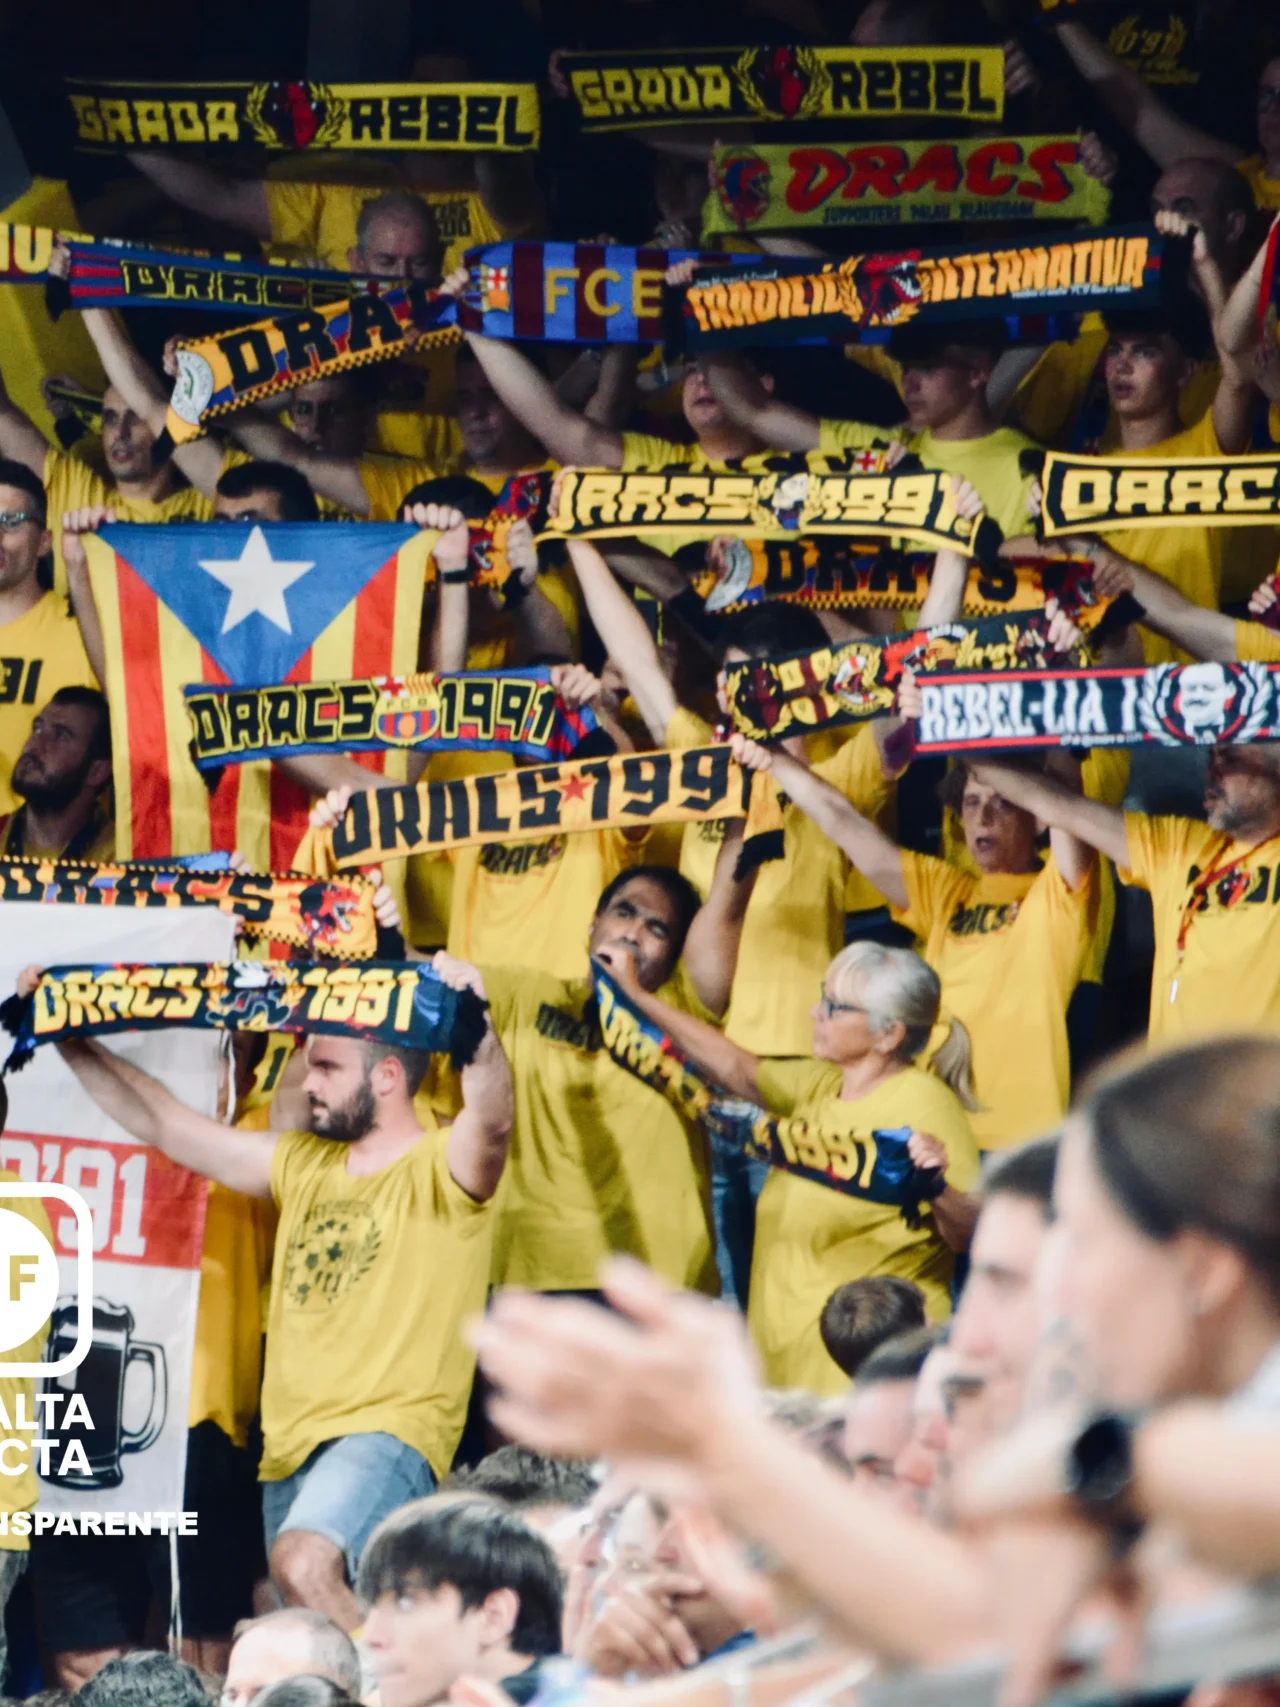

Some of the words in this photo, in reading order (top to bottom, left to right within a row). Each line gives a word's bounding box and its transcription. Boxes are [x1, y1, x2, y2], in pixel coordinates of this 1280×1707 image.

[70, 95, 239, 143] GRADA
[570, 65, 732, 117] GRADA
[785, 142, 1083, 214] DRACS
[918, 237, 1150, 302] ALTERNATIVA
[188, 682, 375, 757] DRACS
[438, 677, 556, 746] 1991
[33, 967, 204, 1035] DRACS
[303, 967, 420, 1032] 1991
[777, 1120, 879, 1189] 1991
